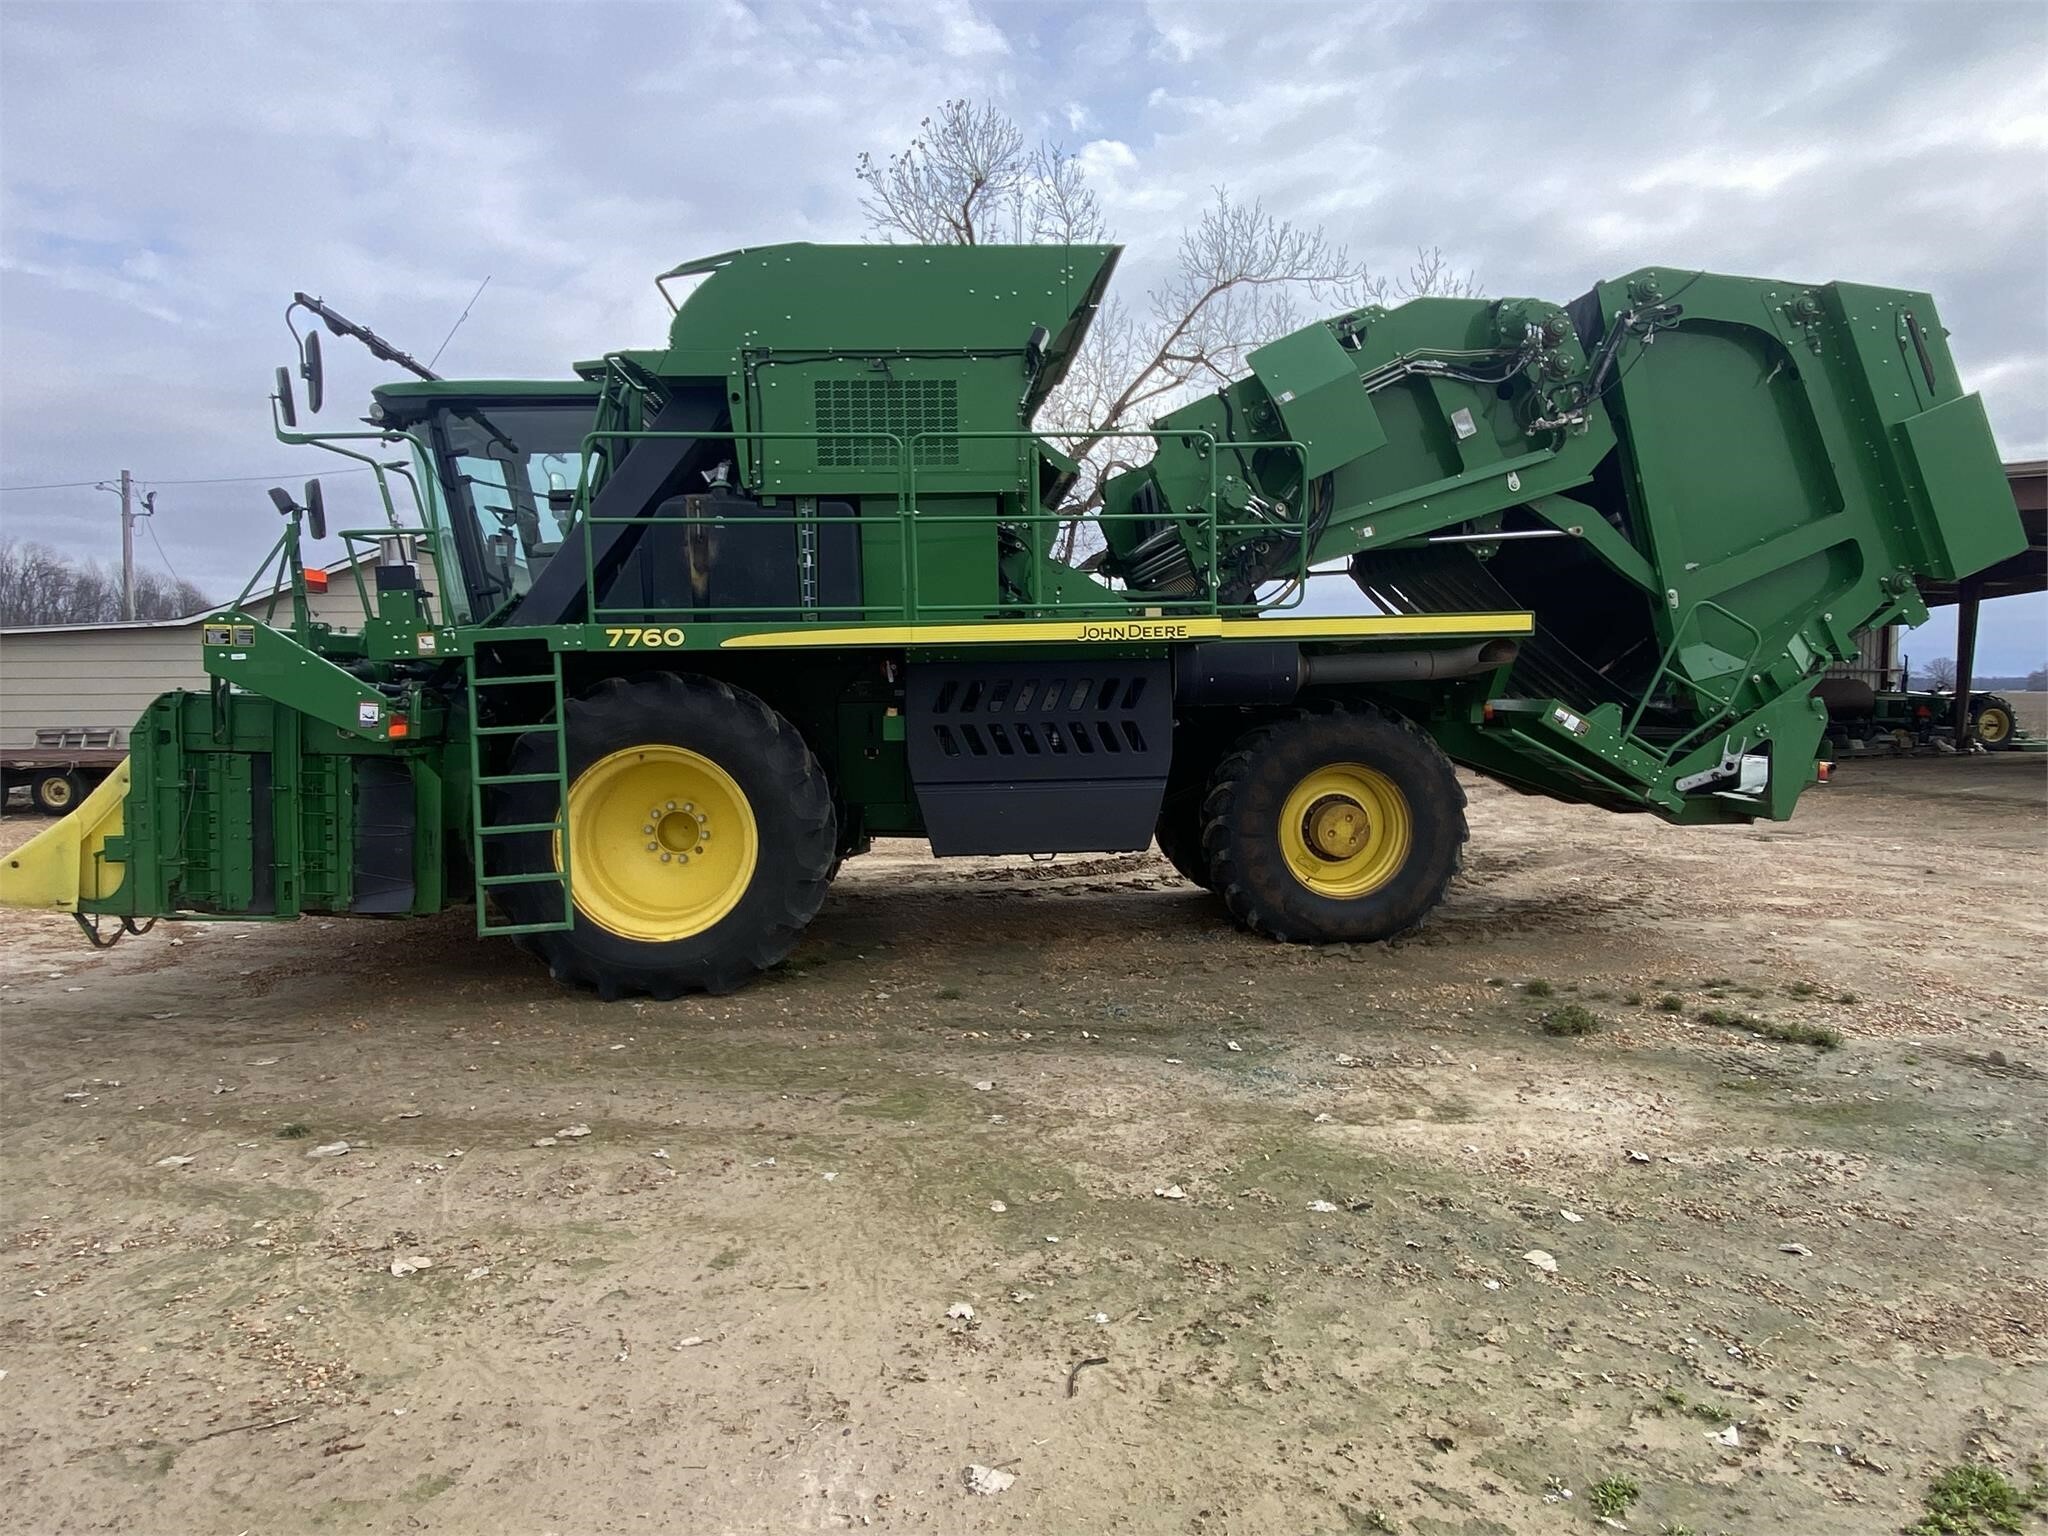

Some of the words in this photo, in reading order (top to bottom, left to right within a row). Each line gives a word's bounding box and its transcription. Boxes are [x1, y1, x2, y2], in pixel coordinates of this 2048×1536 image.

[605, 628, 685, 647] 7760
[1077, 625, 1125, 639] JOHN
[1128, 624, 1187, 638] DEERE
